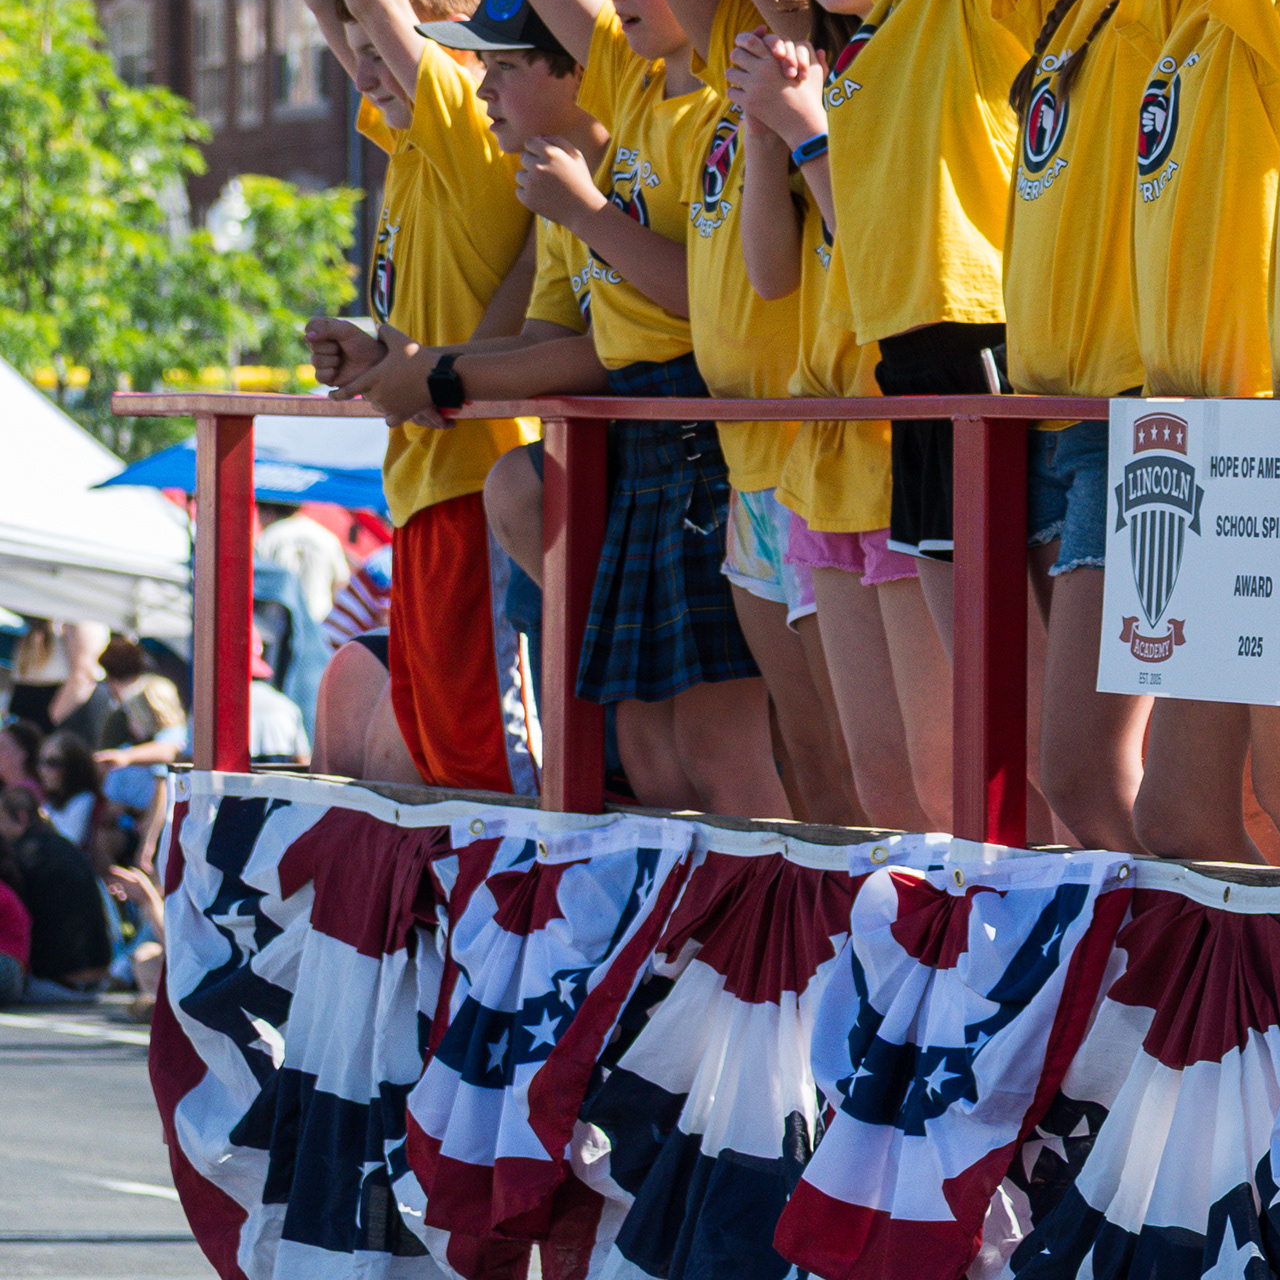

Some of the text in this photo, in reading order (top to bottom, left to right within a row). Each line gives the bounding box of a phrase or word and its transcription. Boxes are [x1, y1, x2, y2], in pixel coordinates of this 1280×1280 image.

[1210, 456, 1239, 478] HOPE
[1241, 456, 1256, 478] OF
[1128, 466, 1191, 501] LINCOLN
[1216, 515, 1260, 538] SCHOOL
[1233, 575, 1273, 598] AWARD
[1134, 639, 1170, 658] ACADEMY
[1238, 635, 1263, 657] 2025
